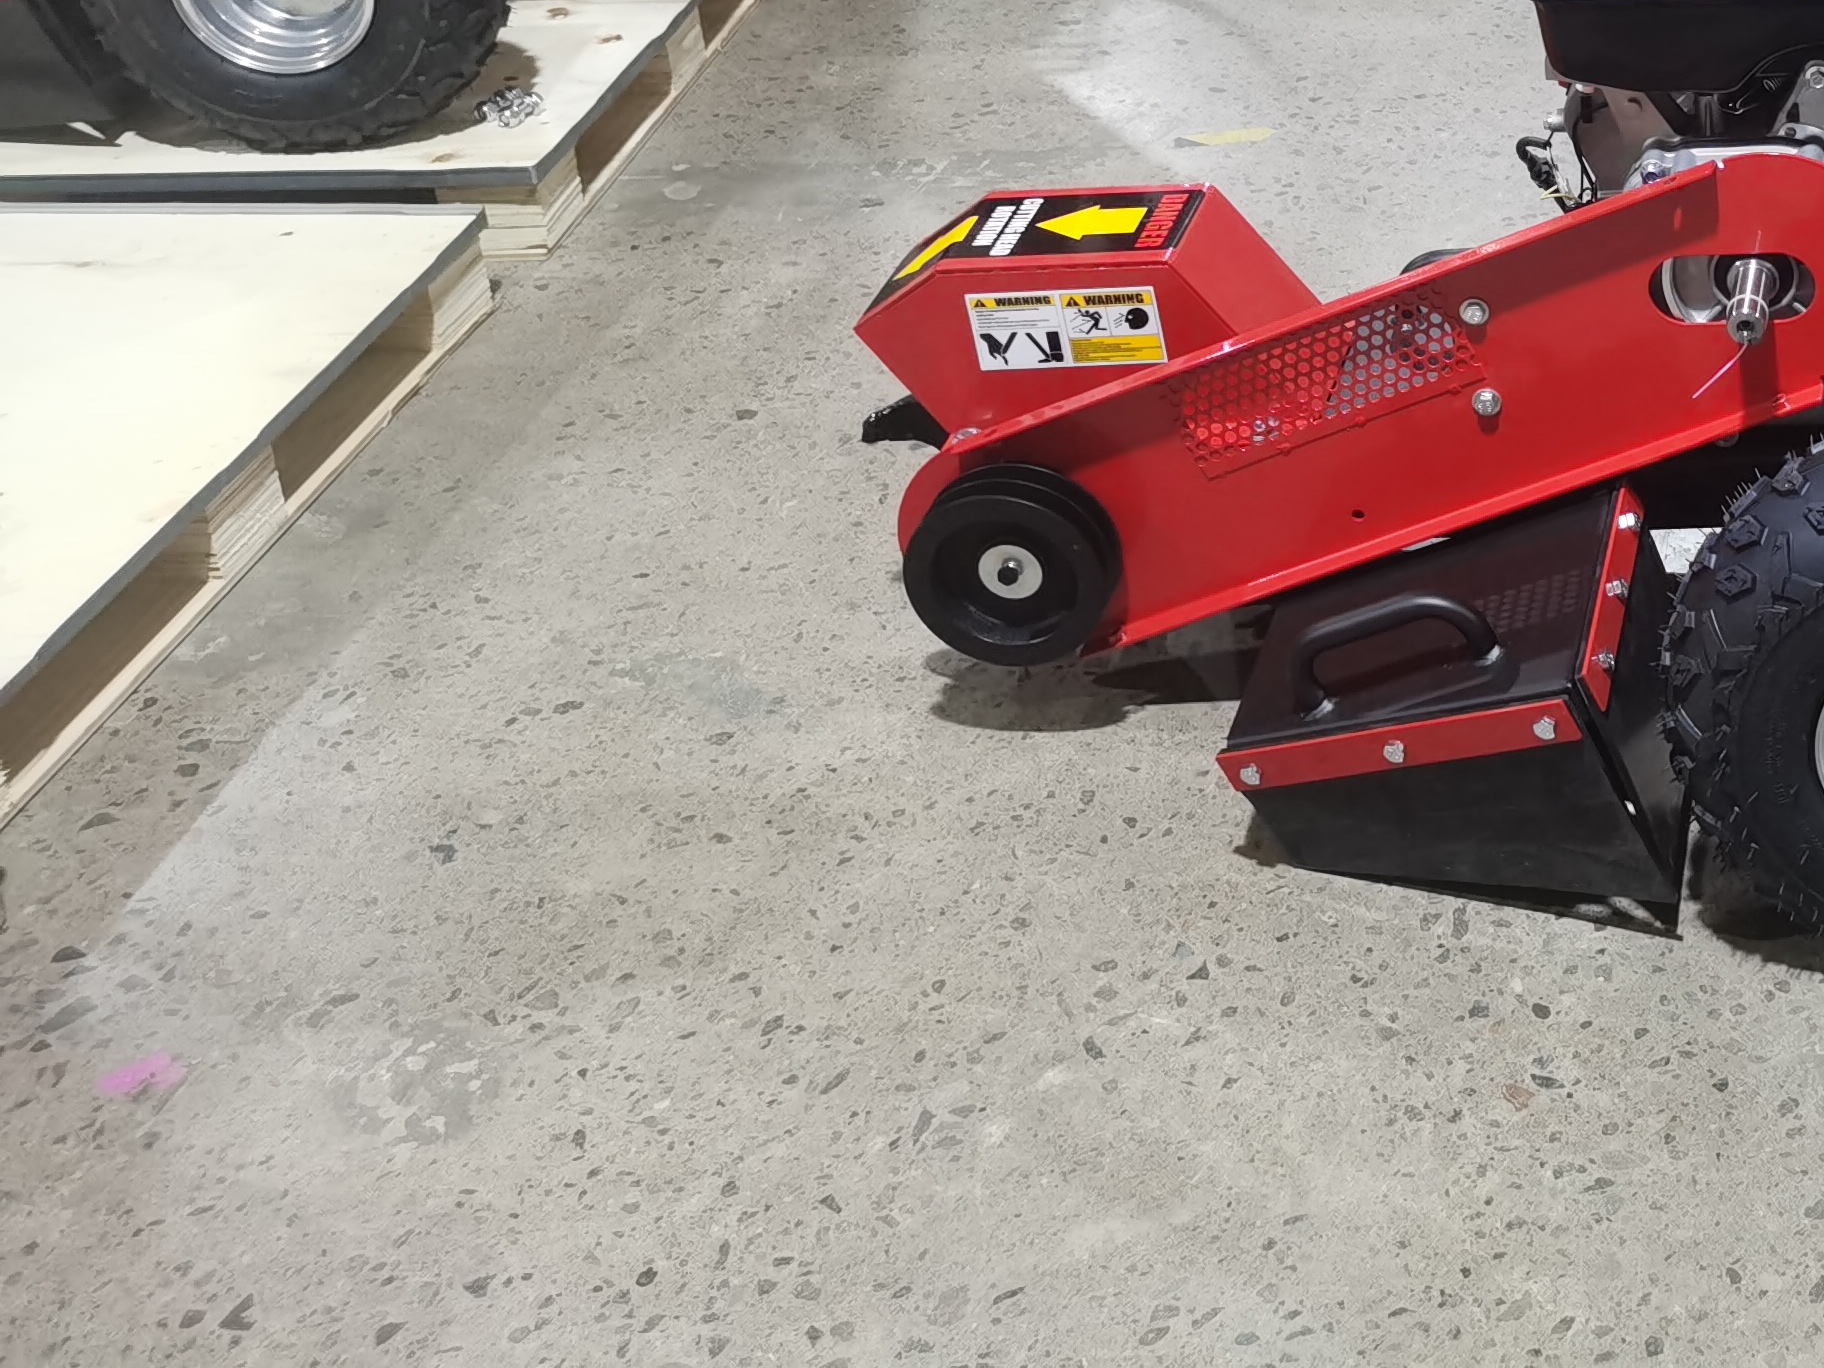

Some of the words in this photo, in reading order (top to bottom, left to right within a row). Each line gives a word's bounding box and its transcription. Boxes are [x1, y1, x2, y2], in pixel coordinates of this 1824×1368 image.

[971, 205, 1016, 247] ROTATION
[1005, 198, 1044, 234] CUTTING
[1135, 193, 1190, 248] DANGER
[988, 232, 1022, 256] HEAD
[994, 296, 1051, 307] WARNING
[1084, 293, 1145, 306] WARNING
